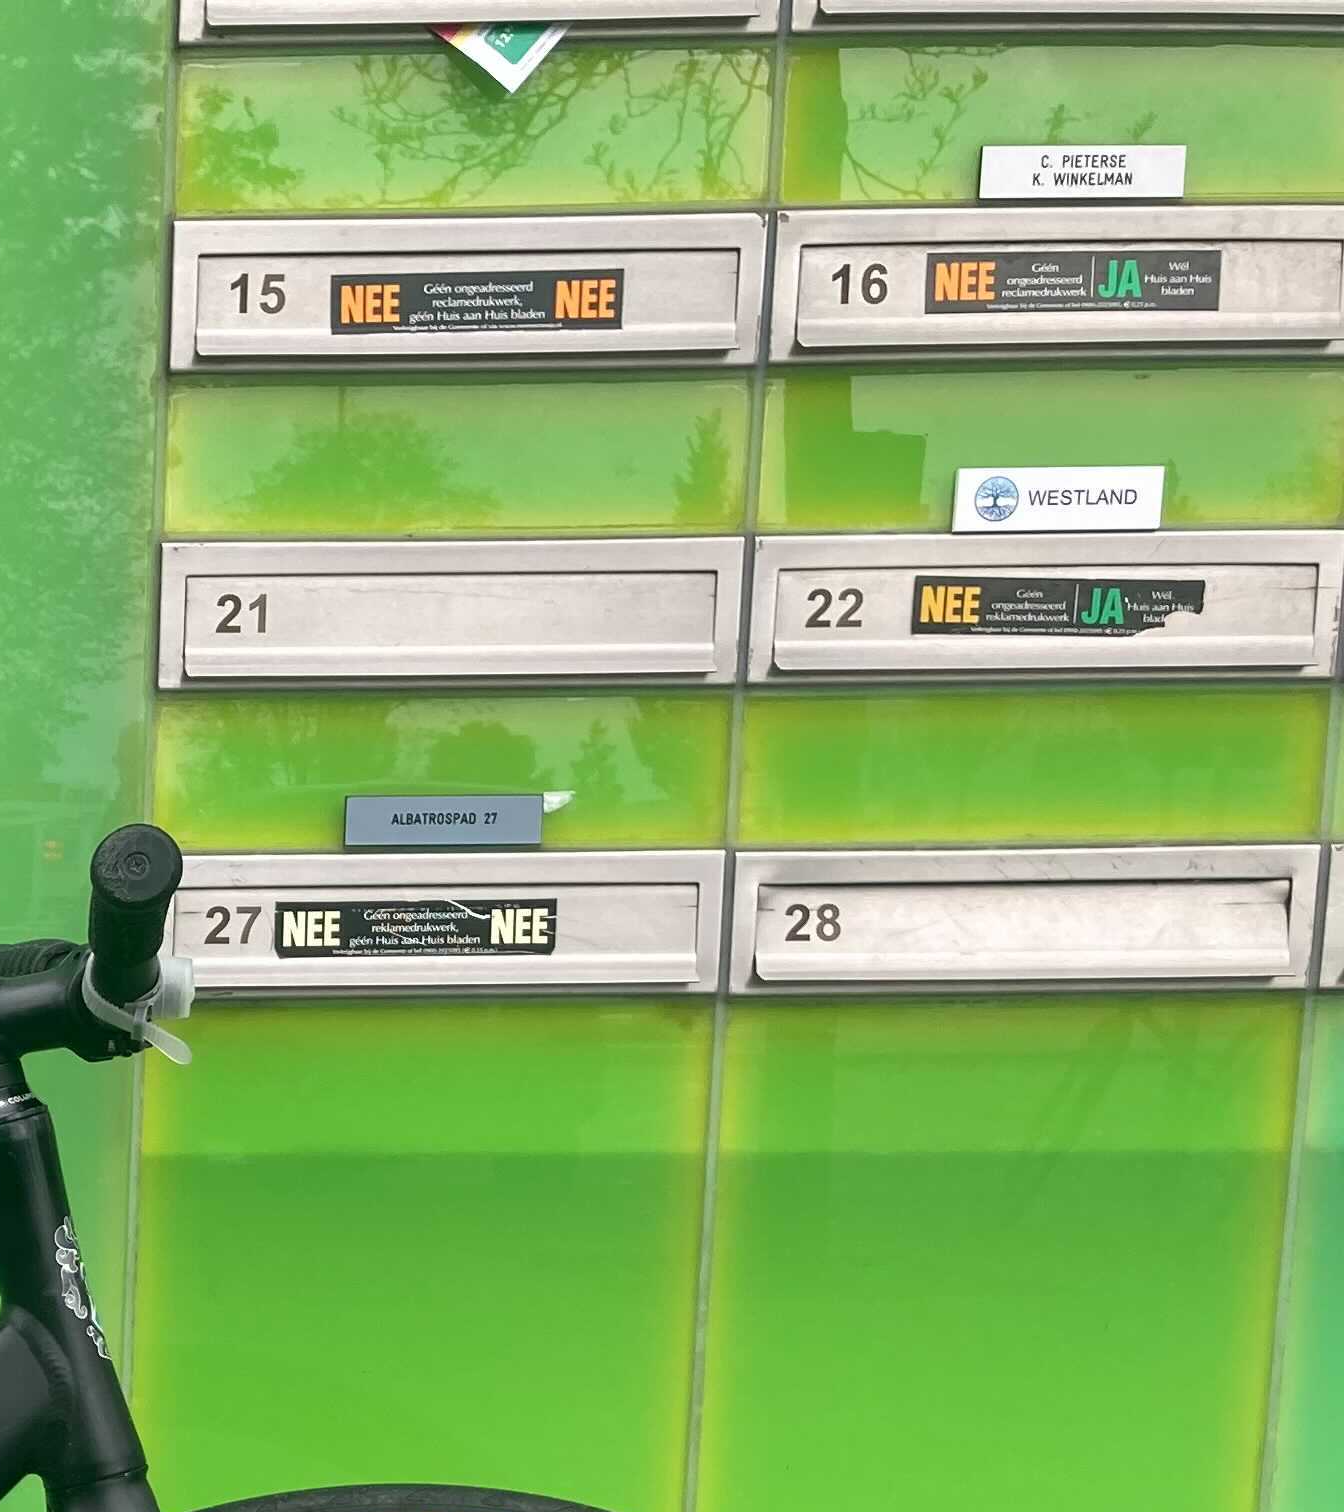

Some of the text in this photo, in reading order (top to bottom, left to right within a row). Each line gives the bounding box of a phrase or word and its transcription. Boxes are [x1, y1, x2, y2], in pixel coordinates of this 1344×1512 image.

[1032, 172, 1133, 186] K. WINKELMAN
[1041, 154, 1127, 168] C. PIETERSE
[229, 273, 287, 314] 15
[424, 281, 534, 296] Géén ongeadresseerd
[831, 262, 889, 305] 16
[934, 261, 996, 302] NEE
[1006, 274, 1083, 288] ongeadresseerd
[1098, 260, 1142, 298] JA
[1144, 274, 1167, 283] Huis
[1189, 274, 1212, 283] Huis
[1161, 286, 1194, 296] bladen
[340, 284, 400, 324] NEE
[409, 309, 545, 324] géén Huis aan Huis bladen
[555, 279, 616, 319] NEE
[1028, 489, 1138, 506] WESTLAND
[215, 593, 268, 633] 21
[805, 588, 865, 629] 22
[919, 585, 981, 624] NEE
[991, 601, 1066, 612] ongeadresseerd
[1081, 587, 1125, 625] JA
[1128, 602, 1150, 611] Huis
[391, 812, 498, 825] ALBATROSPAD 27
[205, 904, 263, 946] 27
[282, 910, 340, 947] NEE
[490, 908, 549, 944] NEE
[785, 903, 841, 941] 28
[349, 936, 373, 948] géén
[376, 936, 398, 945] Huis
[422, 935, 444, 944] Huis
[446, 935, 480, 944] bladen
